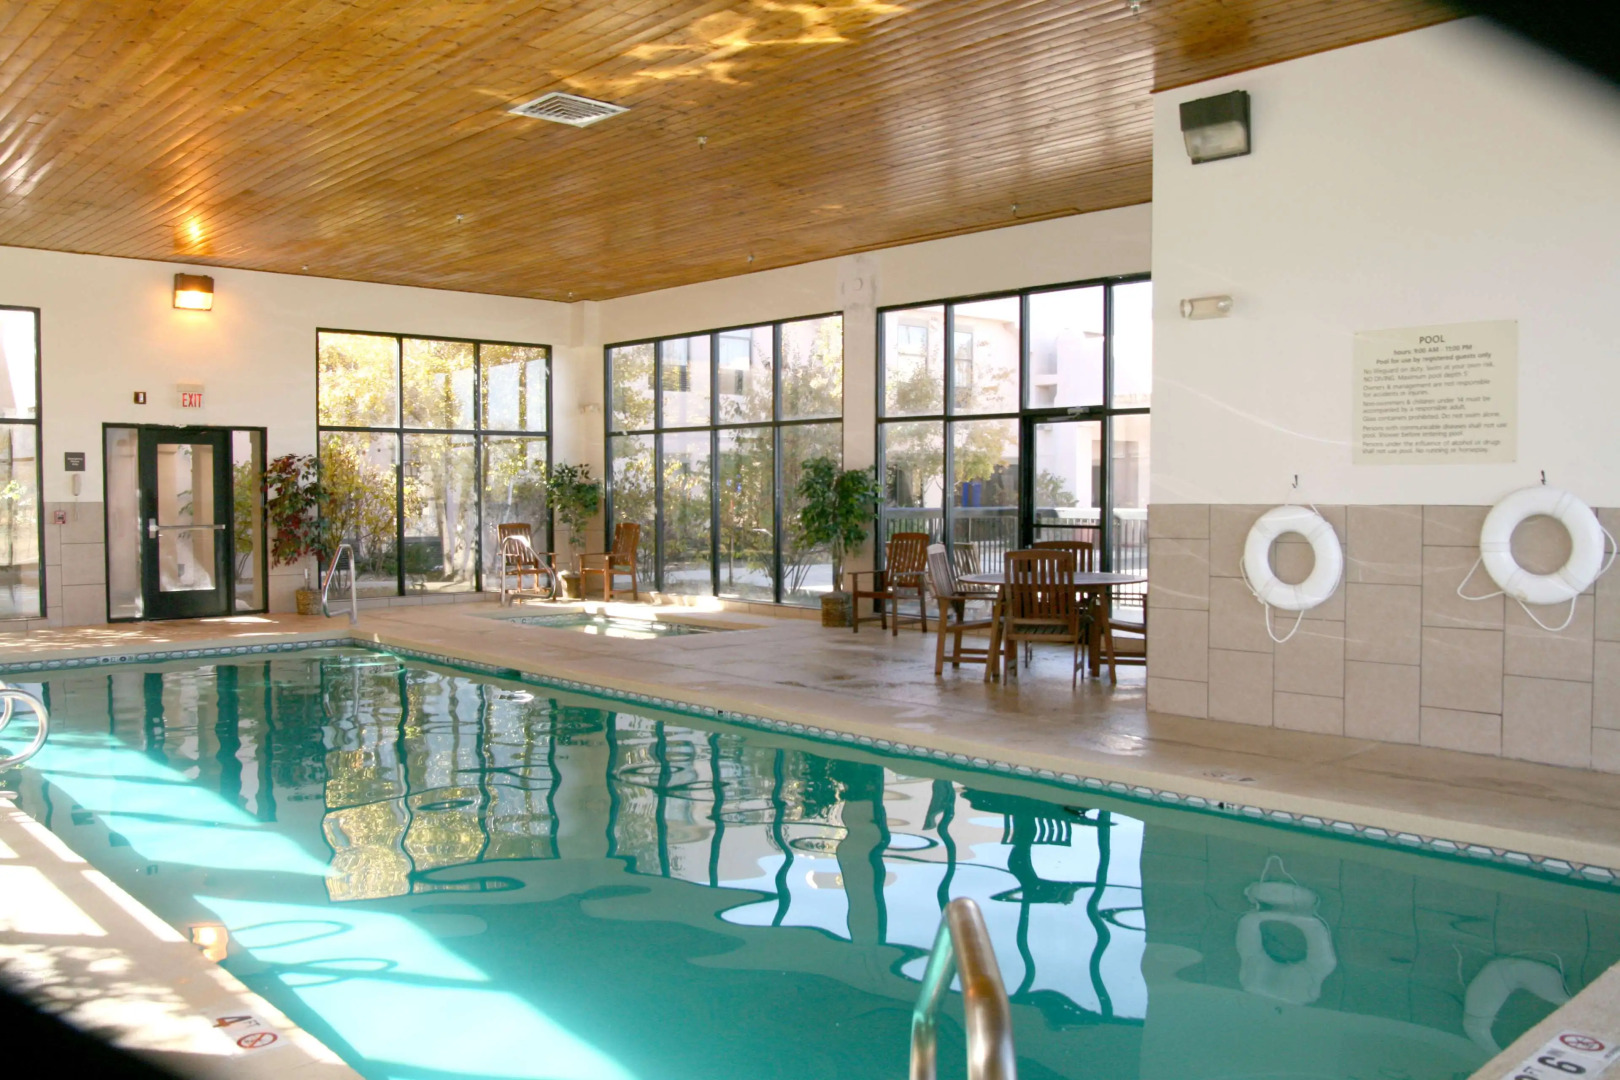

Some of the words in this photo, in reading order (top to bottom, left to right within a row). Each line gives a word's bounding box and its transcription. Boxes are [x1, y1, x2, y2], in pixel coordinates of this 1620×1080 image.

[1419, 335, 1445, 344] POOL
[182, 392, 202, 408] EXIT
[212, 1016, 252, 1028] 4
